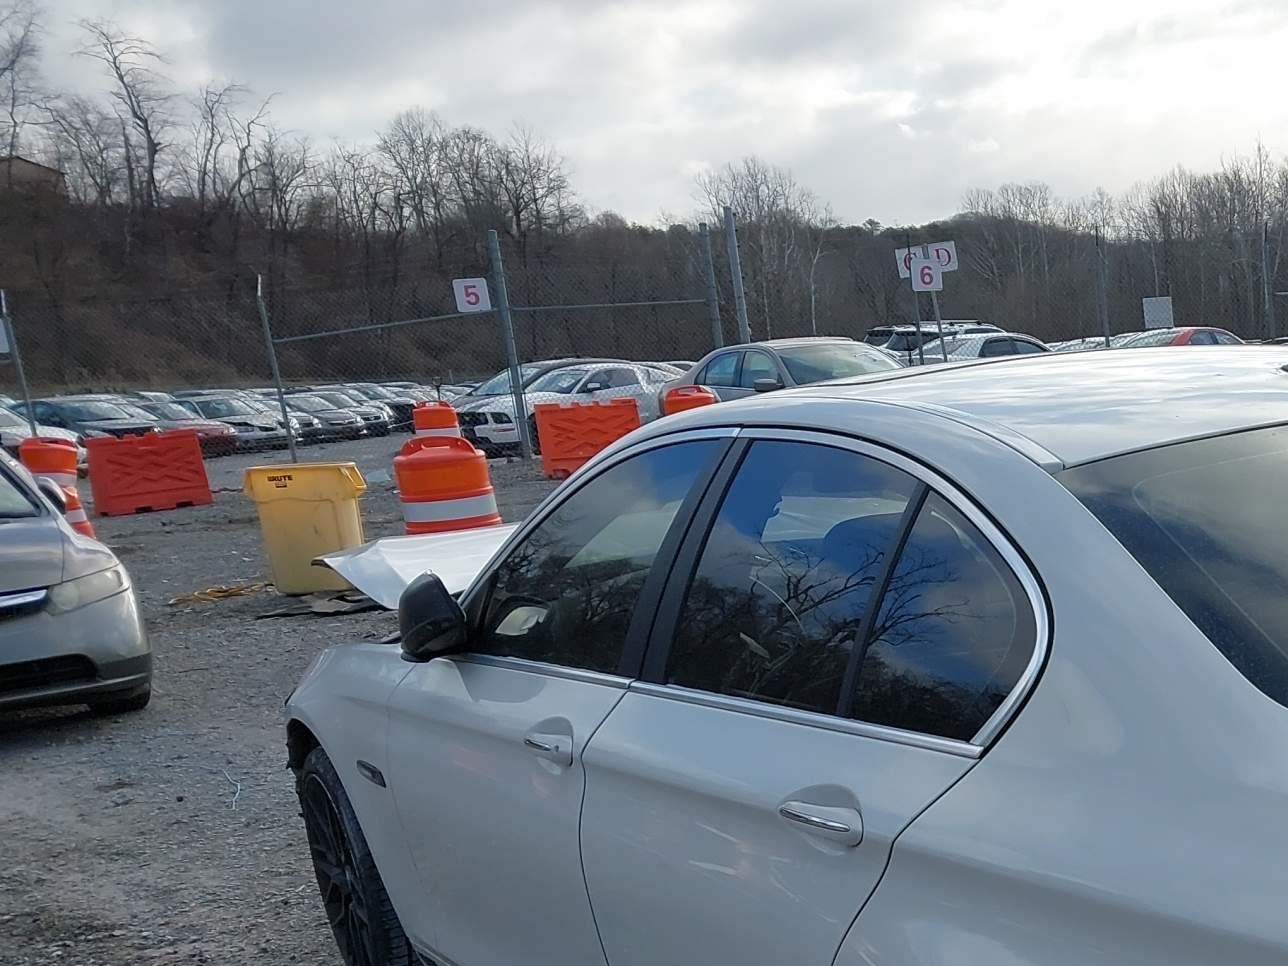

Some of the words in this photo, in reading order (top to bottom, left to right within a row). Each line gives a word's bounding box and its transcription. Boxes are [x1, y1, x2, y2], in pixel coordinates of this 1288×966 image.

[935, 247, 952, 267] D
[920, 265, 934, 286] 6
[463, 284, 480, 306] 5
